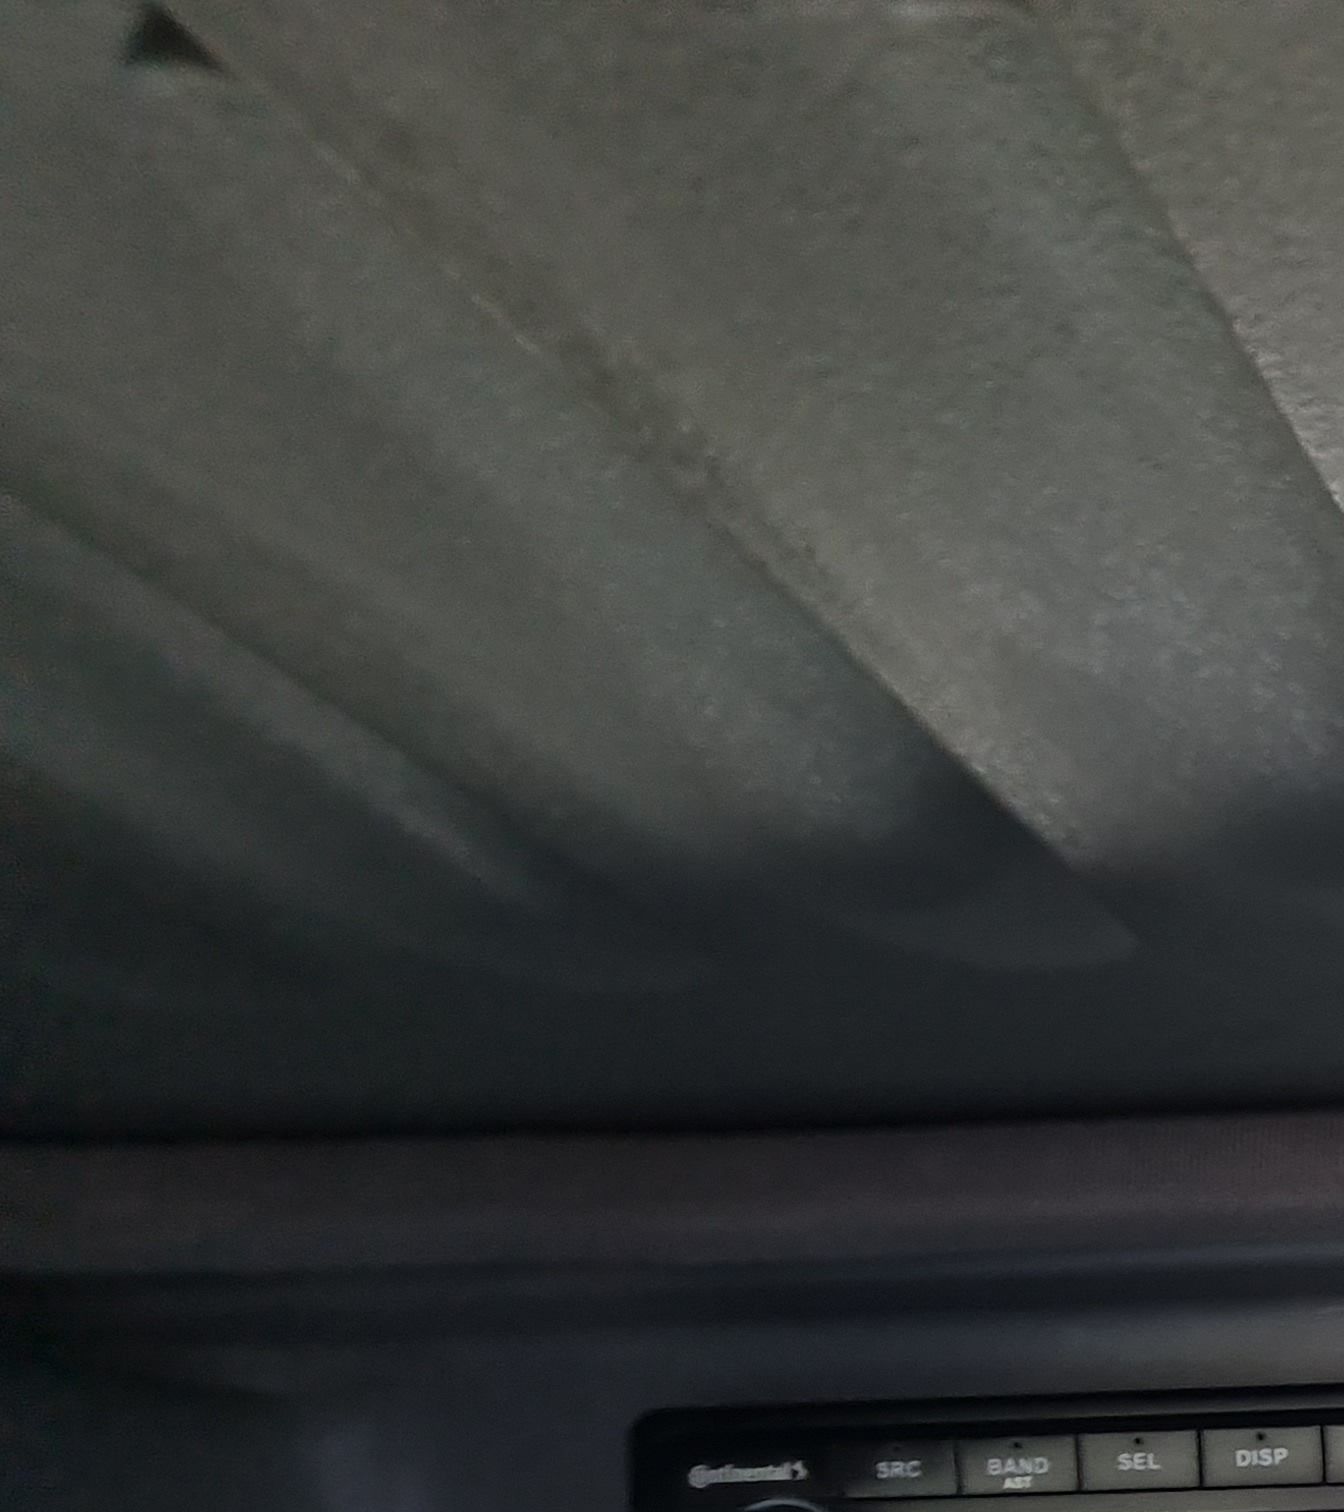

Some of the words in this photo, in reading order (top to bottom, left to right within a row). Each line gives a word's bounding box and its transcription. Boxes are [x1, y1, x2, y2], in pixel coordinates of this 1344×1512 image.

[987, 1457, 1049, 1476] BAND
[1117, 1453, 1161, 1471] SEL
[1235, 1447, 1288, 1467] DISP
[876, 1460, 921, 1479] SRC
